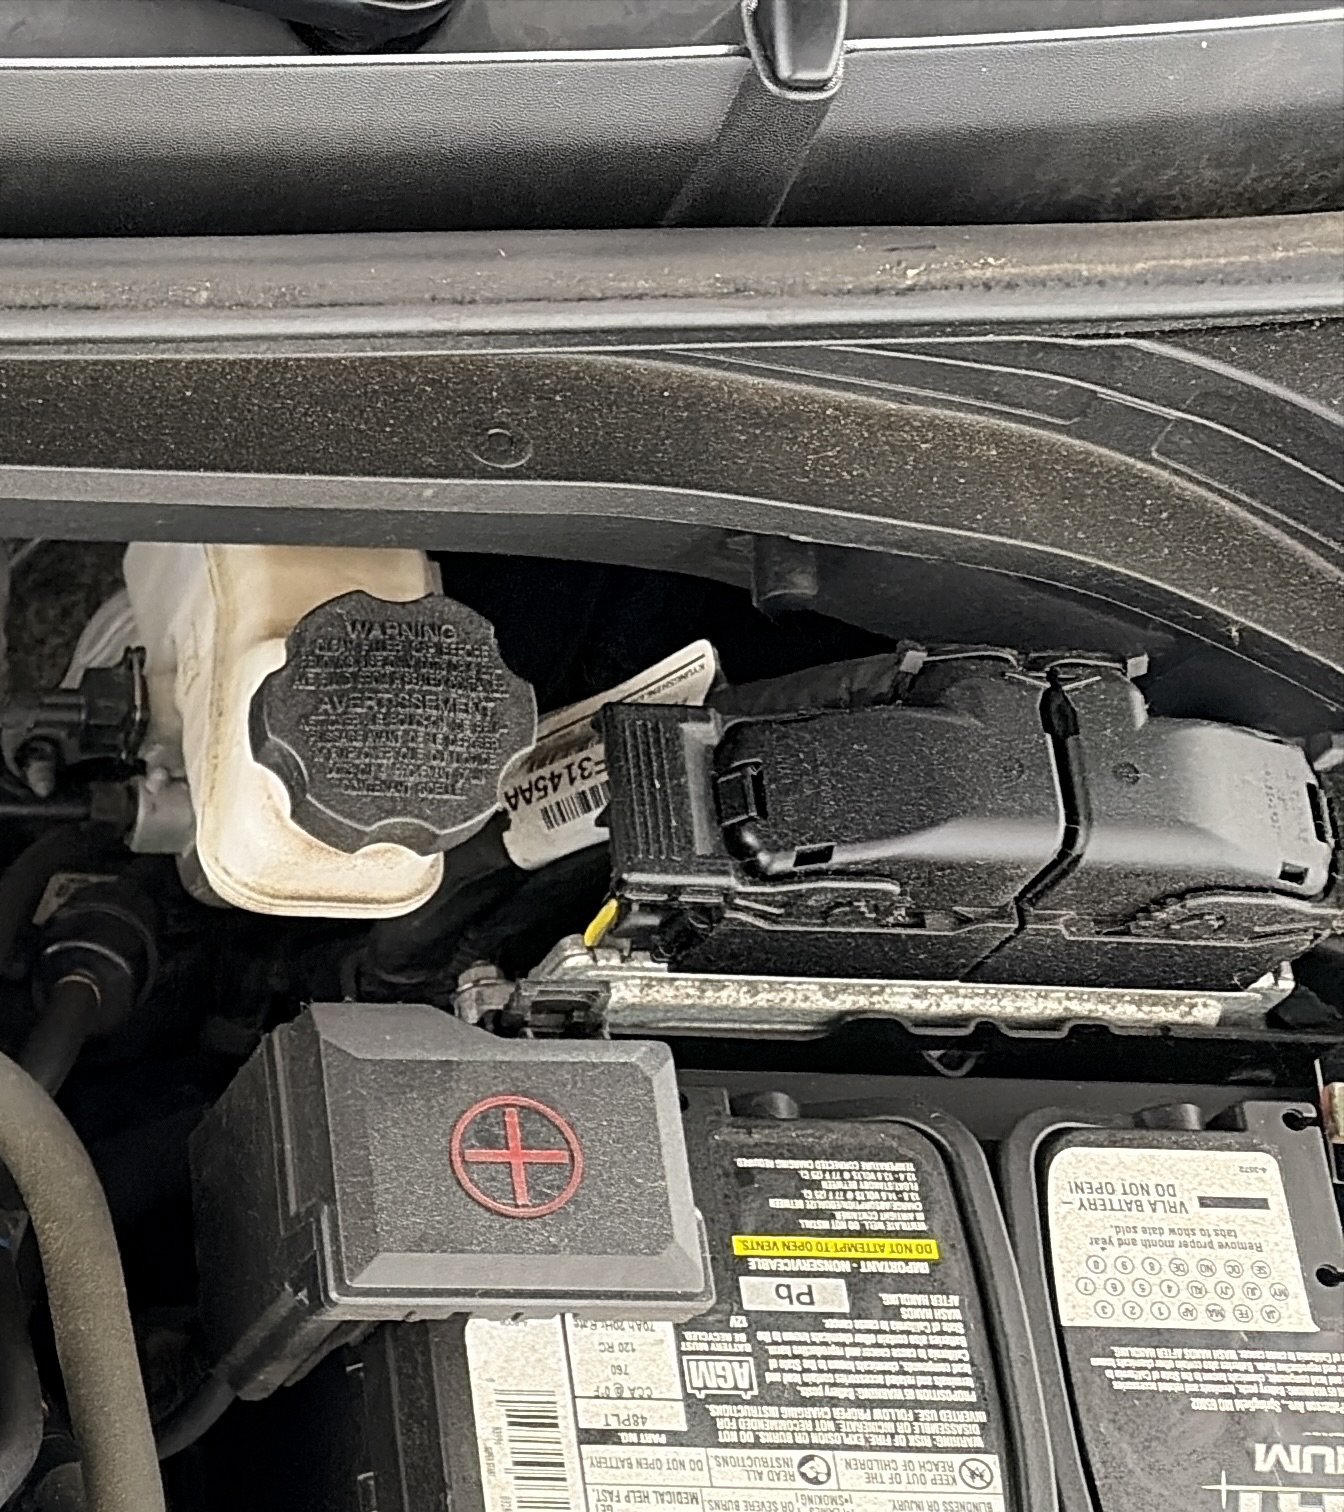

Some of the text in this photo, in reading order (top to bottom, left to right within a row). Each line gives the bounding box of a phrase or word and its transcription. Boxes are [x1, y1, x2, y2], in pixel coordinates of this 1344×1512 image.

[346, 620, 457, 640] WARNING
[1068, 1181, 1176, 1197] DO NOT OPEN!
[1077, 1197, 1143, 1213] BATTERY
[1147, 1199, 1188, 1214] VRLA
[1141, 1225, 1164, 1236] date
[1168, 1226, 1196, 1237] show
[1199, 1227, 1211, 1238] to
[1213, 1228, 1237, 1239] tabs
[781, 1240, 812, 1252] OPEN
[815, 1241, 829, 1253] TO
[833, 1241, 885, 1254] ATTEMPT
[888, 1242, 912, 1255] NOT
[915, 1243, 932, 1255] DO
[1088, 1234, 1262, 1252] Remove proper month and year
[748, 1257, 850, 1272] NONSERVICEABLE
[859, 1260, 929, 1274] IMPORTANT
[1174, 1263, 1185, 1271] DE
[1201, 1264, 1212, 1272] NO
[1228, 1265, 1239, 1273] OC
[1256, 1266, 1267, 1274] SE
[775, 1283, 813, 1306] Pb
[1192, 1285, 1202, 1293] AU
[1219, 1286, 1230, 1295] JY
[1247, 1287, 1258, 1295] JU
[1275, 1288, 1286, 1296] MY
[1183, 1308, 1194, 1316] AP
[1238, 1309, 1249, 1317] FE
[1265, 1310, 1276, 1318] JA
[598, 1341, 635, 1352] 120 RC
[610, 1363, 629, 1375] 760
[688, 1360, 750, 1389] AGM
[780, 1407, 831, 1419] CHARGING
[832, 1408, 871, 1420] PROPER
[872, 1409, 913, 1420] FOLLOW
[938, 1410, 986, 1422] INVERTED
[604, 1413, 647, 1427] 48PLT
[716, 1418, 736, 1430] FOR
[738, 1419, 812, 1431] RECOMMENDED
[814, 1420, 835, 1431] NOT
[896, 1422, 911, 1433] OR
[912, 1422, 980, 1434] DISASSEMBLE
[639, 1433, 666, 1444] PART
[717, 1431, 738, 1443] NOT
[739, 1432, 754, 1443] DO
[794, 1432, 809, 1444] OR
[810, 1433, 865, 1445] EXPLOSION
[892, 1434, 906, 1446] OF
[907, 1434, 931, 1446] RISK
[635, 1457, 662, 1470] OPEN
[665, 1458, 685, 1470] NOT
[688, 1458, 703, 1471] DO
[901, 1458, 915, 1472] OF
[918, 1459, 954, 1473] REACH
[746, 1470, 795, 1482] READ ALL
[864, 1471, 957, 1486] KEEP OUT OF THE
[623, 1489, 649, 1504] HELP
[652, 1490, 699, 1505] MEDICAL
[743, 1499, 778, 1512] SEVERE
[780, 1500, 794, 1512] OR
[926, 1500, 939, 1512] OR
[942, 1500, 993, 1512] BLINDNESS
